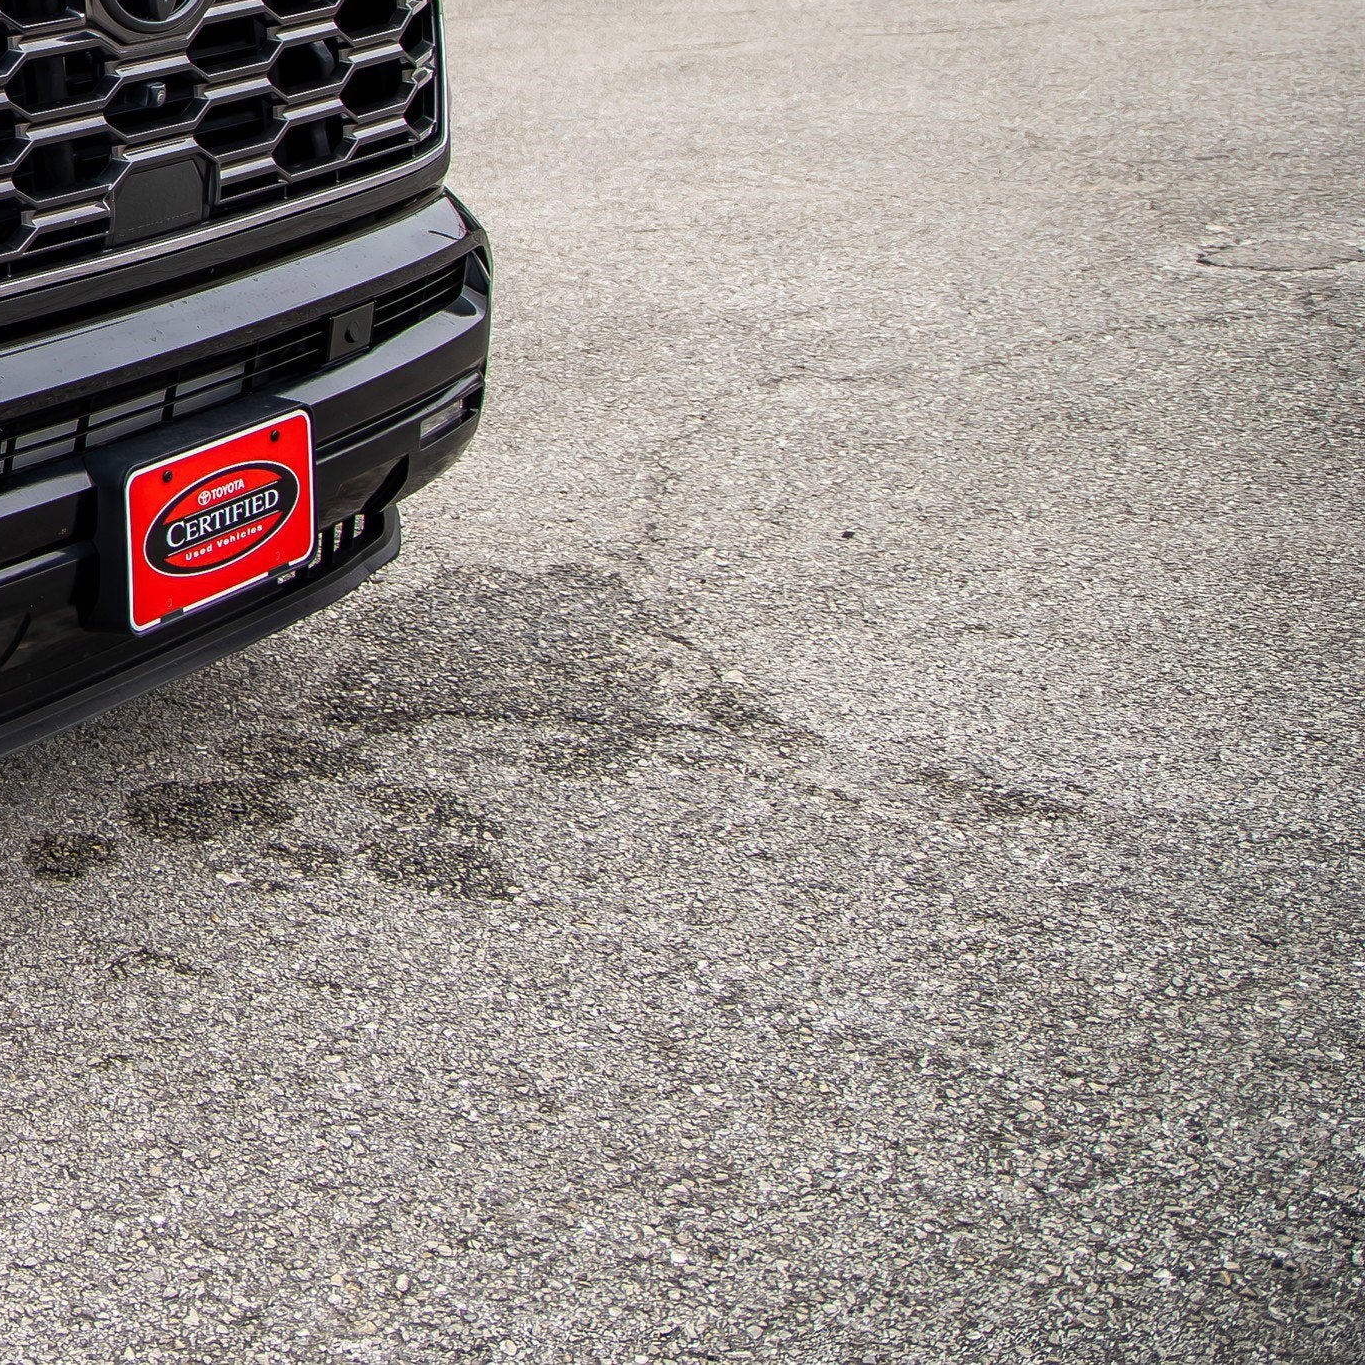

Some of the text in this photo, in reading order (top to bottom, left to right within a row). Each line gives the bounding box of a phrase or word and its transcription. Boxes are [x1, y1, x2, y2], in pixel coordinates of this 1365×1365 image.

[210, 478, 245, 501] TOYOTA
[166, 488, 280, 549] CERTIFIED
[184, 523, 264, 561] Used Vehicles
